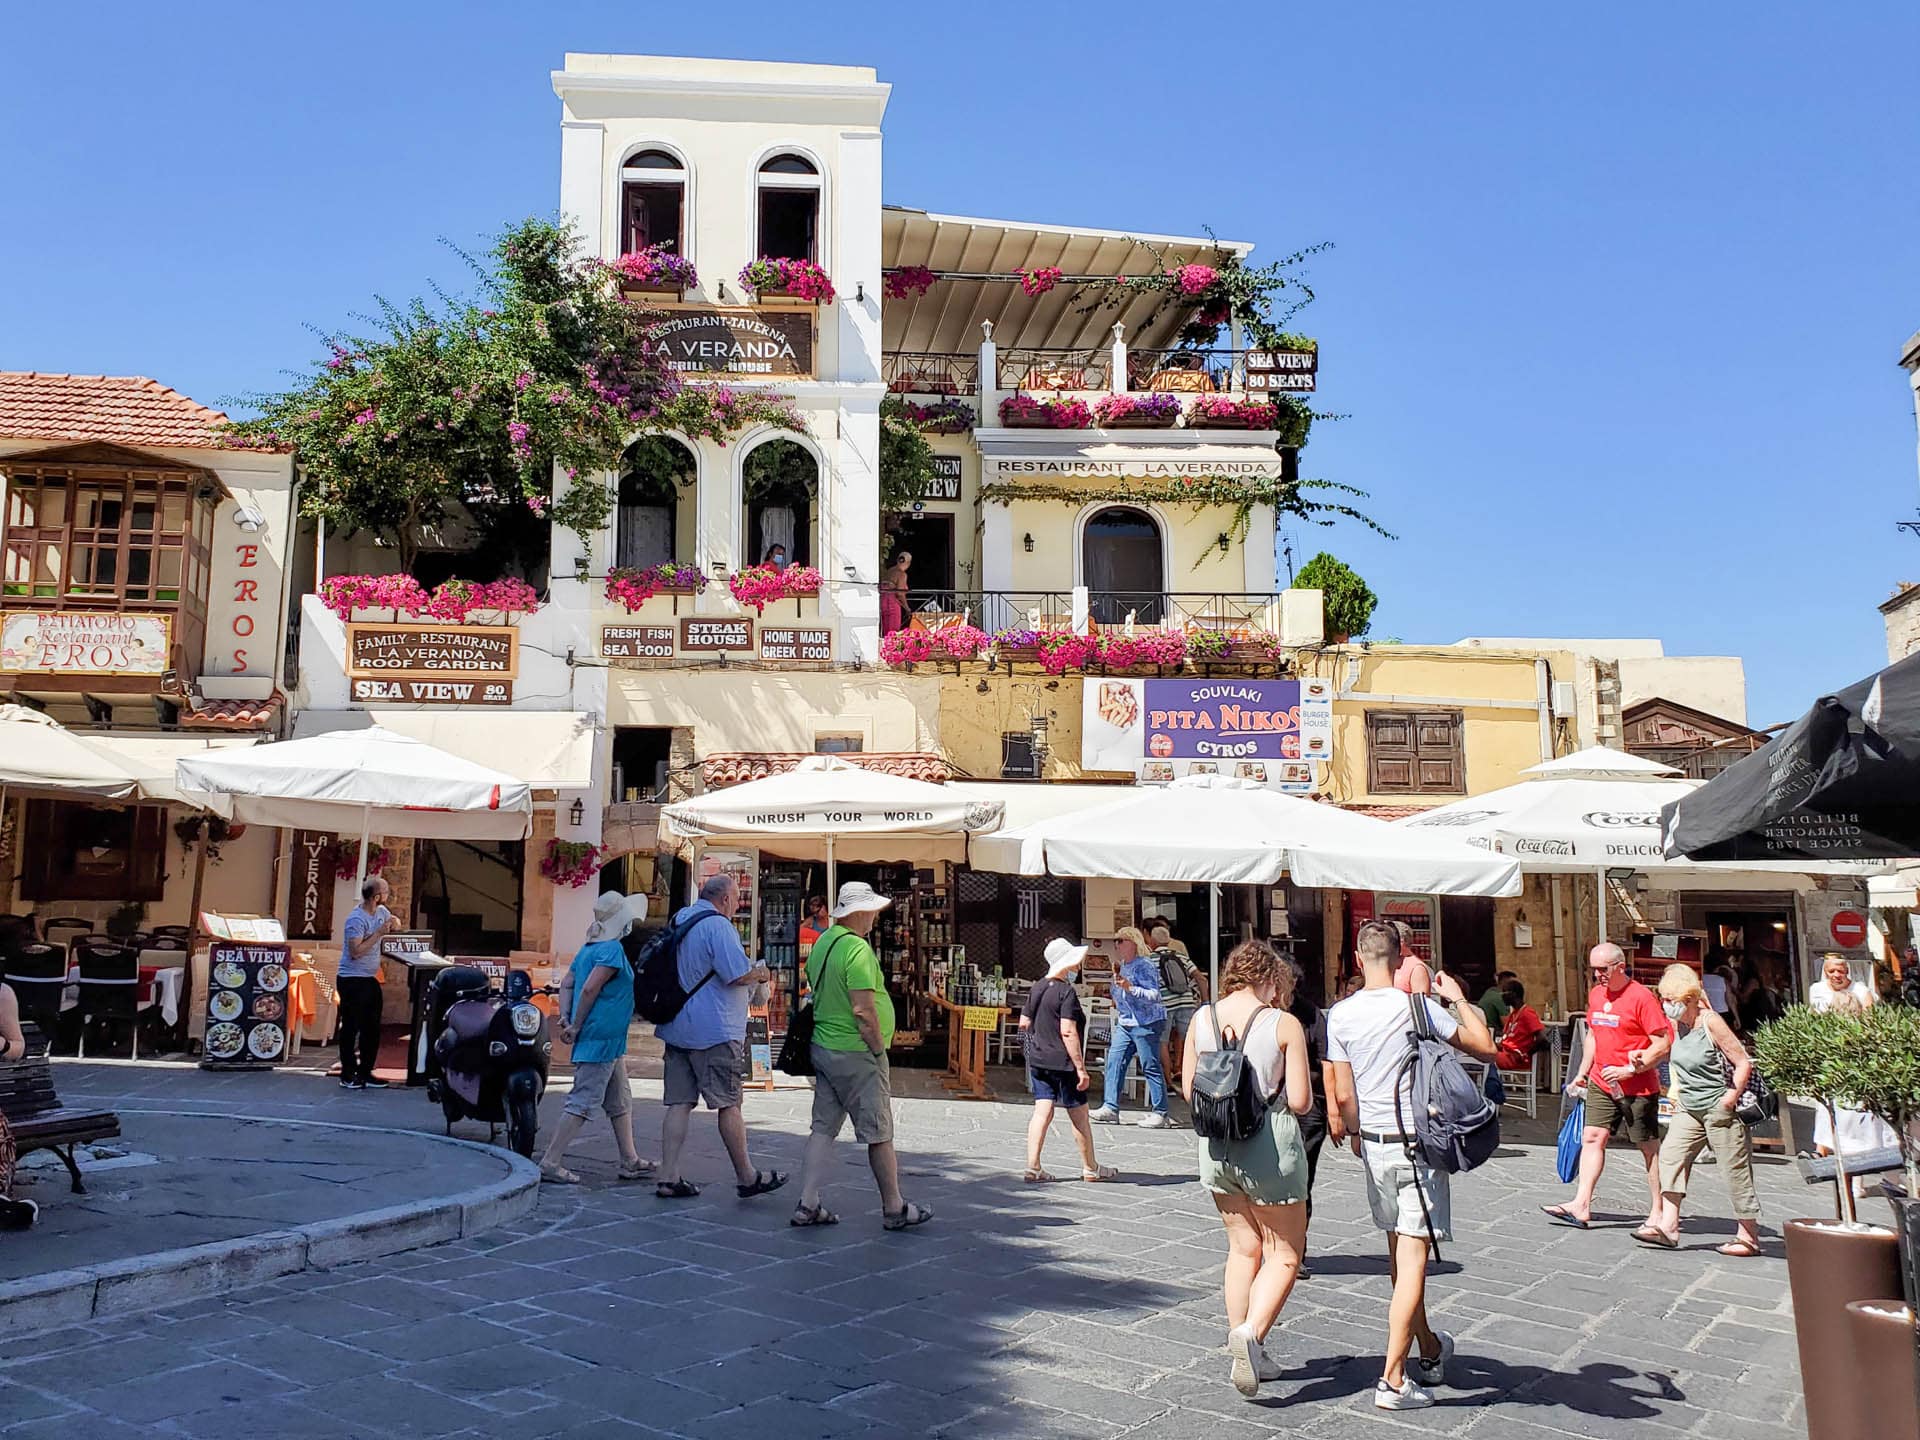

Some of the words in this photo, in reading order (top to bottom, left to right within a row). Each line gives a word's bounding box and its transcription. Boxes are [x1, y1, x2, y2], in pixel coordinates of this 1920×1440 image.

[648, 340, 672, 356] A
[681, 340, 796, 358] VERANDA
[668, 360, 704, 371] GRILL
[728, 360, 773, 372] HOUSE
[1248, 353, 1275, 368] SEA
[1277, 353, 1313, 368] VIEW
[1249, 375, 1265, 387] 80
[1268, 374, 1313, 388] SEATS
[999, 461, 1125, 472] RESTAURANT
[1145, 463, 1168, 472] LA
[1175, 463, 1267, 473] VERANDA
[921, 479, 959, 497] IEW
[231, 545, 258, 672] EROS
[37, 614, 136, 629] ΕΣΤΙΑΤΟΡΙΟ
[688, 623, 747, 633] STEAK
[39, 629, 133, 644] Restaurant
[605, 628, 641, 639] FRESH
[648, 629, 672, 639] FISH
[687, 634, 747, 645] HOUSE
[764, 631, 793, 644] HOME
[800, 632, 828, 644] MADE
[357, 634, 407, 651] FAMILY
[420, 633, 508, 653] RESTAURANT
[37, 643, 134, 667] EROS
[378, 648, 399, 658] LA
[406, 648, 485, 660] VERANDA
[603, 645, 629, 655] SEA
[638, 646, 672, 656] FOOD
[763, 647, 796, 658] GREEK
[802, 647, 829, 659] FOOD
[359, 659, 413, 668] ROOF
[424, 660, 504, 669] GARDEN
[355, 681, 404, 698] SEA
[410, 683, 474, 699] VIEW
[485, 685, 505, 695] 80
[1190, 685, 1262, 703] SOUVLAKI
[1150, 710, 1215, 729] PITA
[1197, 741, 1258, 757] GYROS
[747, 813, 805, 824] UNRUSH
[824, 812, 862, 822] YOUR
[884, 811, 933, 821] WORLD
[303, 831, 327, 846] LA
[302, 846, 321, 934] VERANDA
[385, 942, 403, 952] SEA
[405, 943, 430, 952] VIEW
[216, 950, 245, 963] SEA
[248, 951, 286, 963] VIEW
